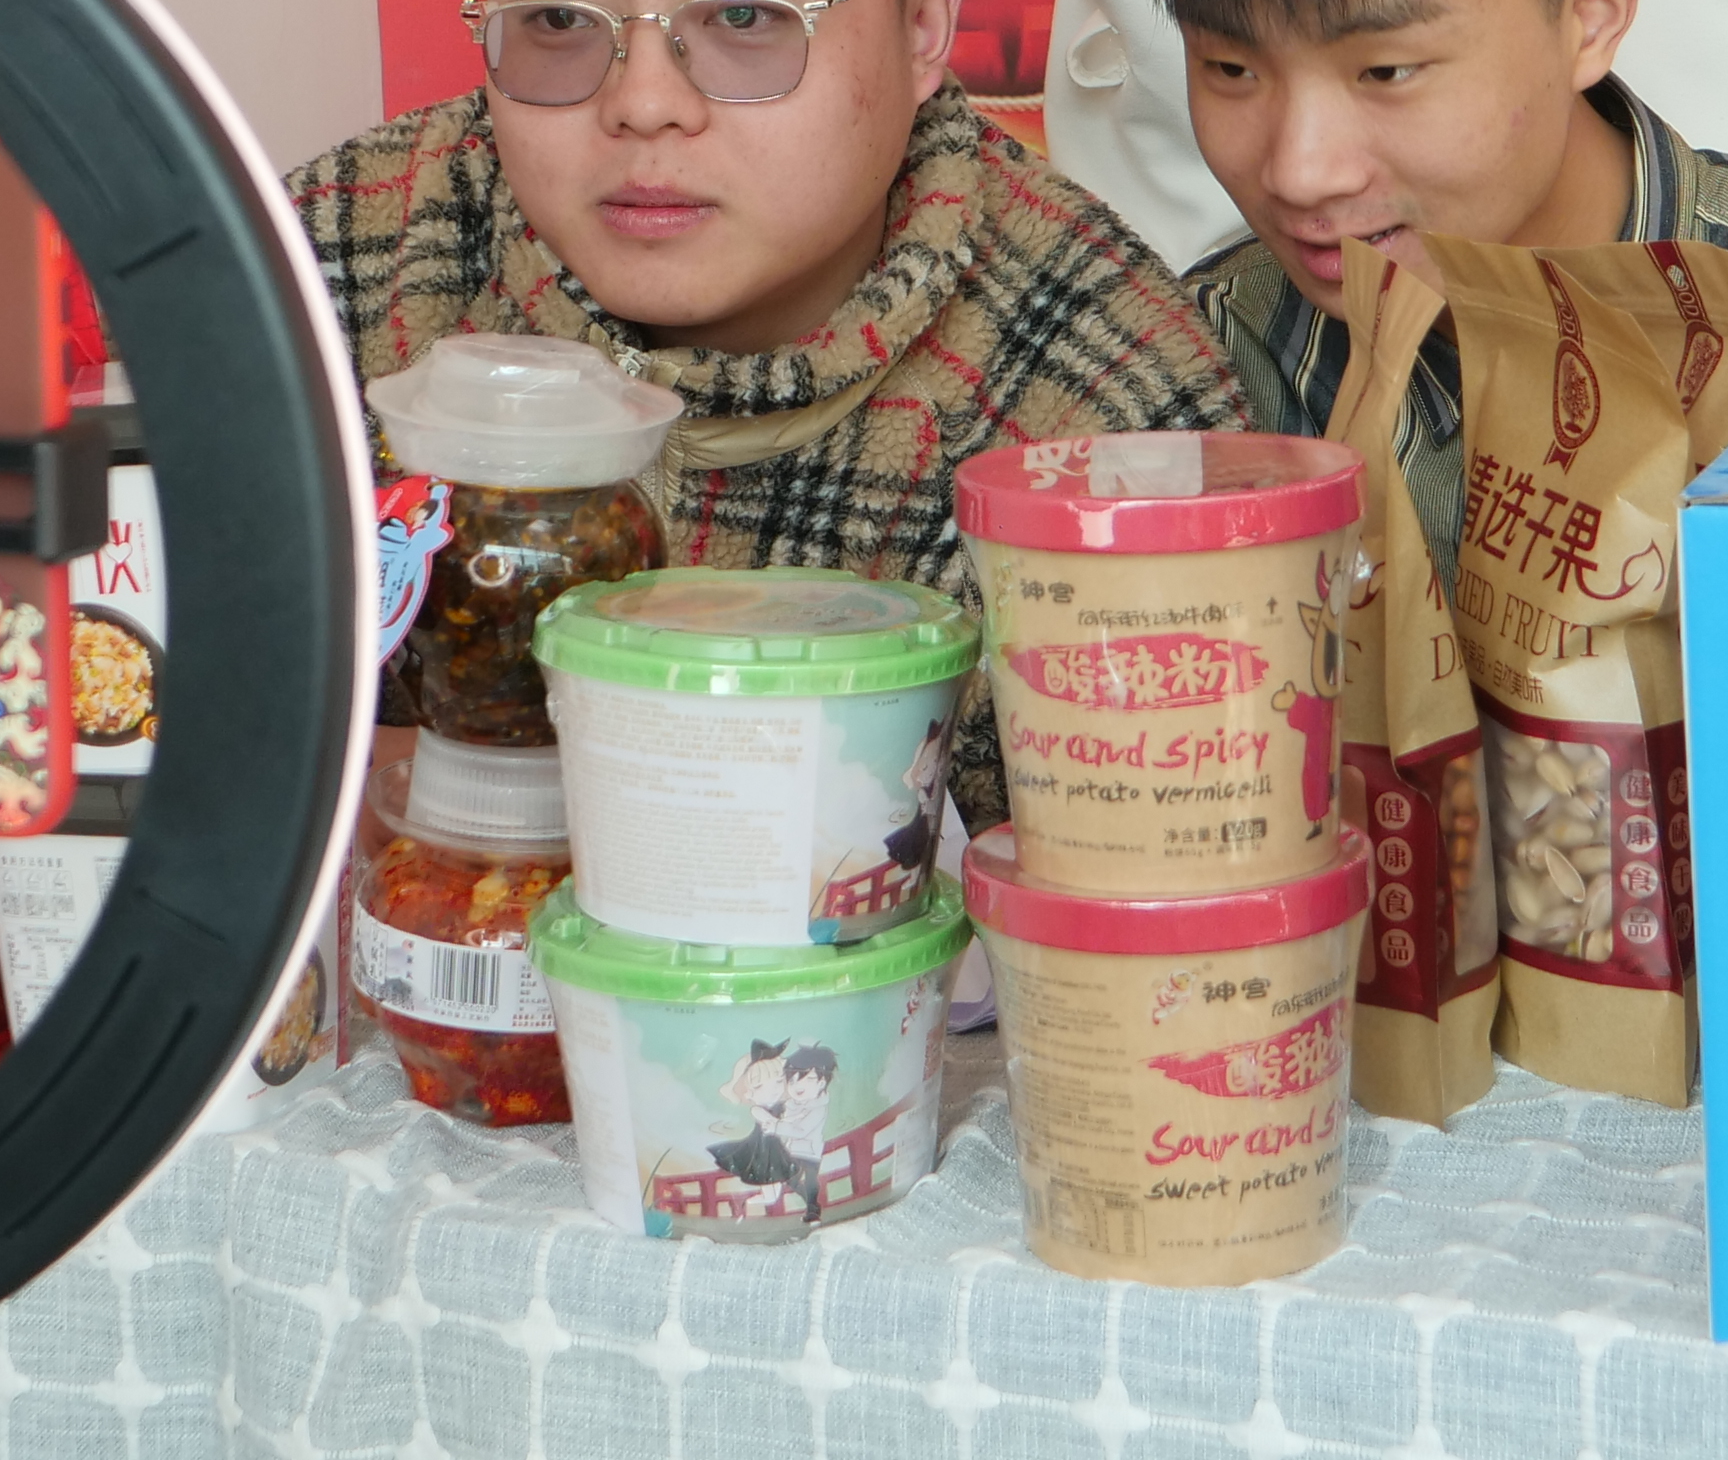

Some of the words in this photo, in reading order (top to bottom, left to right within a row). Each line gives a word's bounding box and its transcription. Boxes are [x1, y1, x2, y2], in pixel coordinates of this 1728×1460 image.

[1454, 562, 1495, 626] RIED
[1499, 591, 1610, 659] FRUIT
[1040, 641, 1237, 703] 酸辣粉
[1066, 731, 1148, 769] and
[1066, 776, 1140, 806] potato
[1152, 773, 1272, 805] vermicelli
[1202, 977, 1271, 1004] 神宫
[1144, 1122, 1240, 1166] Sour
[1245, 1106, 1317, 1156] and
[1144, 1174, 1231, 1200] sweet
[1239, 1163, 1309, 1204] potato
